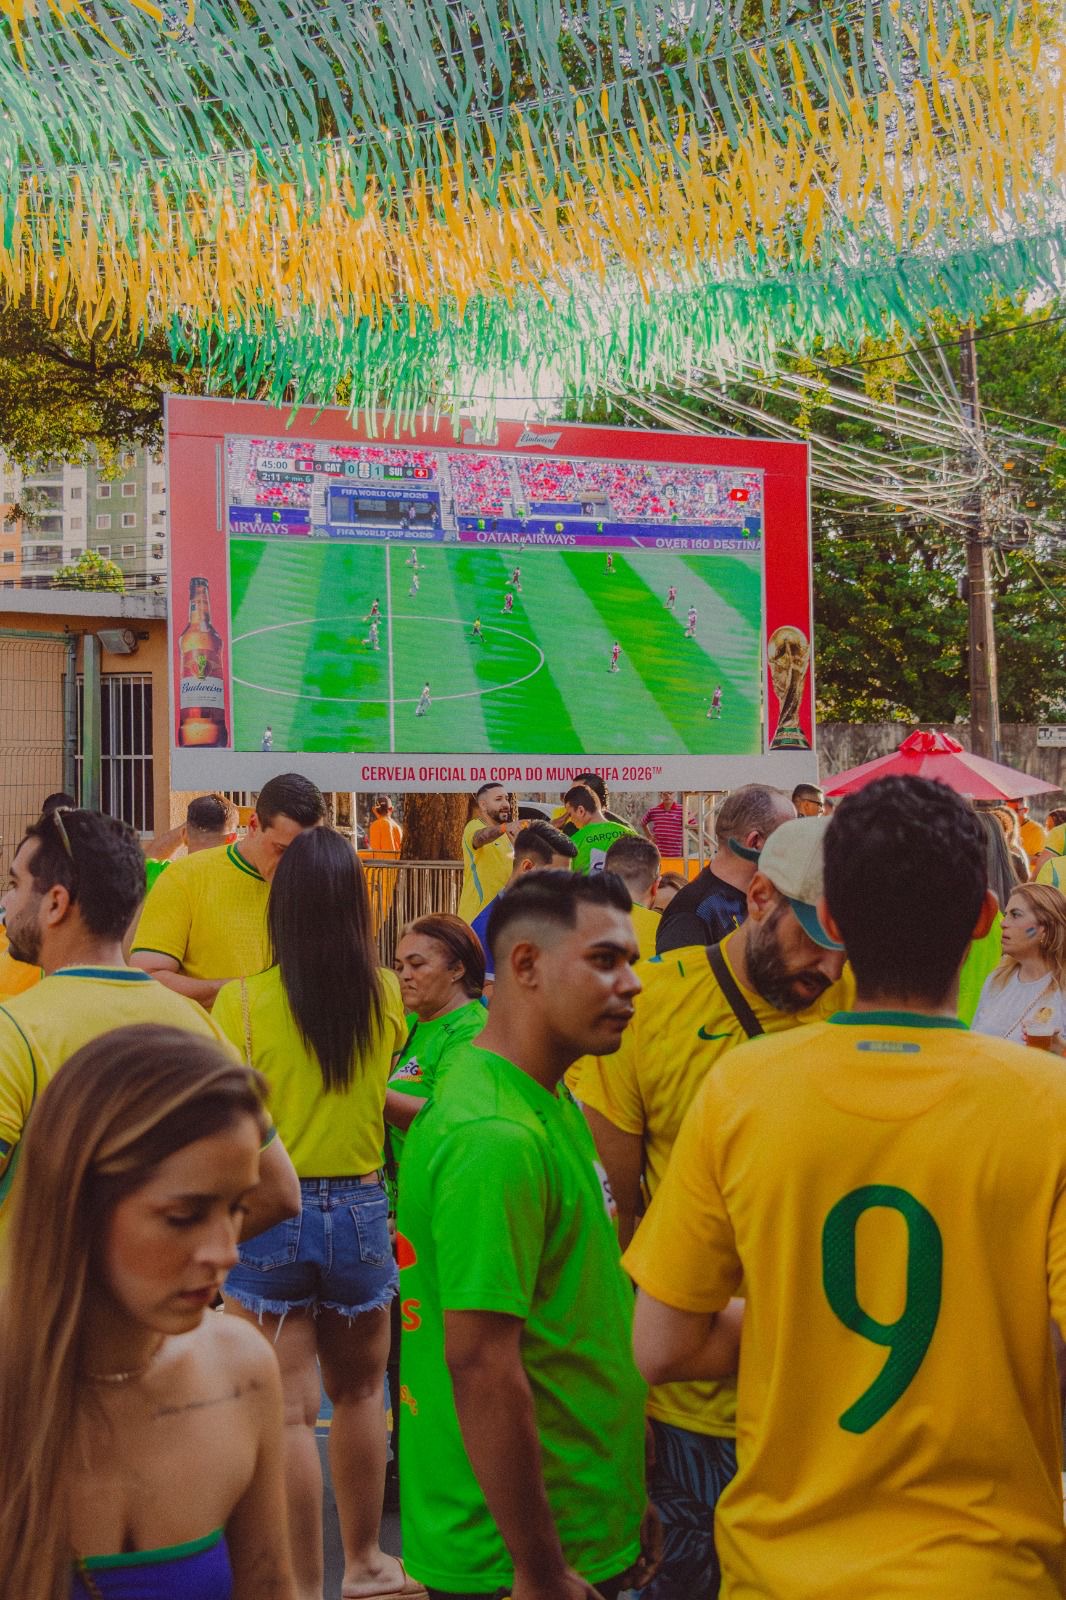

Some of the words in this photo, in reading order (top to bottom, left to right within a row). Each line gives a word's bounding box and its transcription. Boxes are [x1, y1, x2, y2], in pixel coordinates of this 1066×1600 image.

[261, 460, 288, 469] 45:00
[348, 465, 355, 473] 0
[388, 466, 403, 476] SUI
[262, 472, 280, 481] 2:11
[341, 488, 358, 496] FIFA
[359, 489, 386, 497] WORLD
[387, 490, 402, 498] CUP
[336, 528, 356, 536] FIFA
[356, 529, 386, 537] WORLD
[387, 530, 404, 538] CUP
[477, 531, 519, 543] QATAR
[522, 533, 576, 545] AIRWAYS
[655, 538, 688, 549] OVER
[690, 539, 710, 549] 160
[181, 682, 222, 694] Budweiser
[361, 766, 416, 781] CERVEJA
[419, 767, 467, 781] OFICIAL
[470, 767, 487, 781] DA
[490, 767, 522, 781] COPA
[525, 767, 543, 781] DO
[585, 831, 625, 844] GARÇO
[821, 1183, 943, 1435] 9
